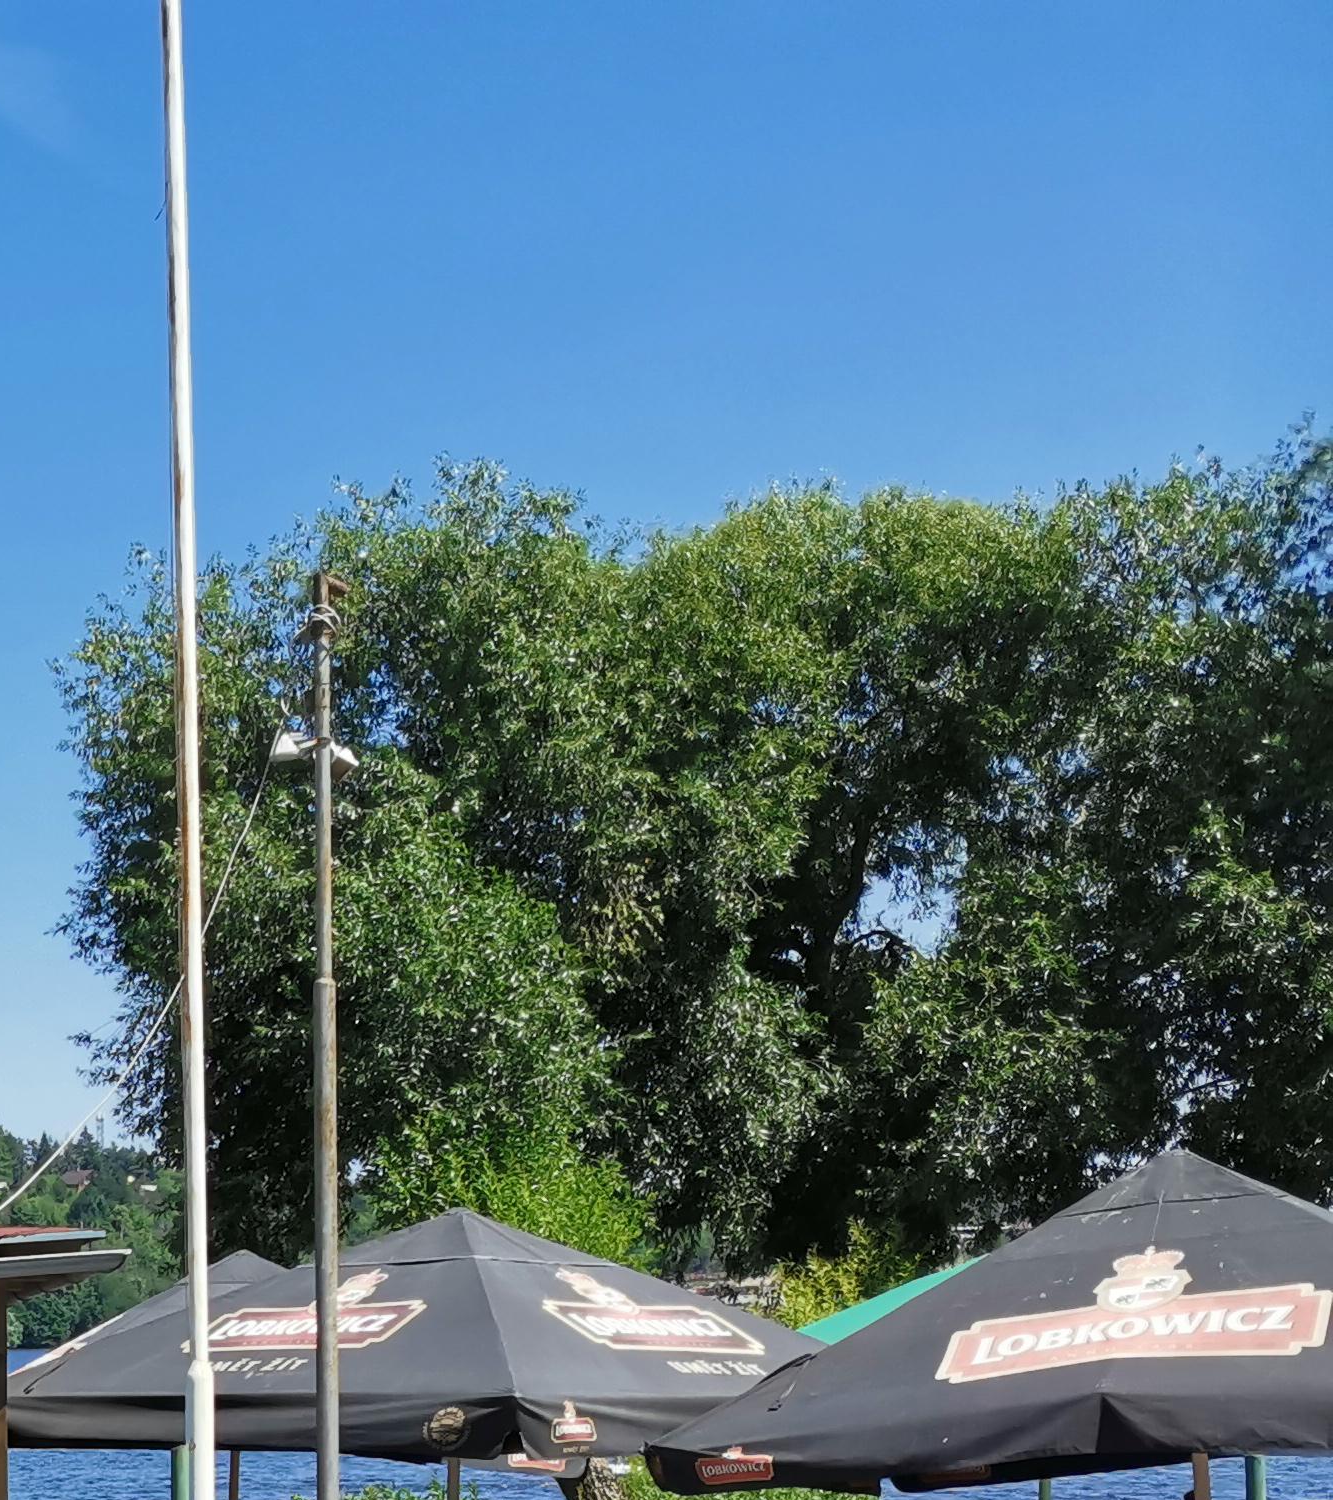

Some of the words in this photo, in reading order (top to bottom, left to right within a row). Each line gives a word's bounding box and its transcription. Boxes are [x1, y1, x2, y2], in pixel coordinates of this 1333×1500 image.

[209, 1313, 398, 1341] LOBKOICZ
[567, 1313, 733, 1337] LOBKOWICZ
[971, 1305, 1298, 1366] LOBKOWICZ
[701, 1461, 766, 1478] LOBKOWICZ
